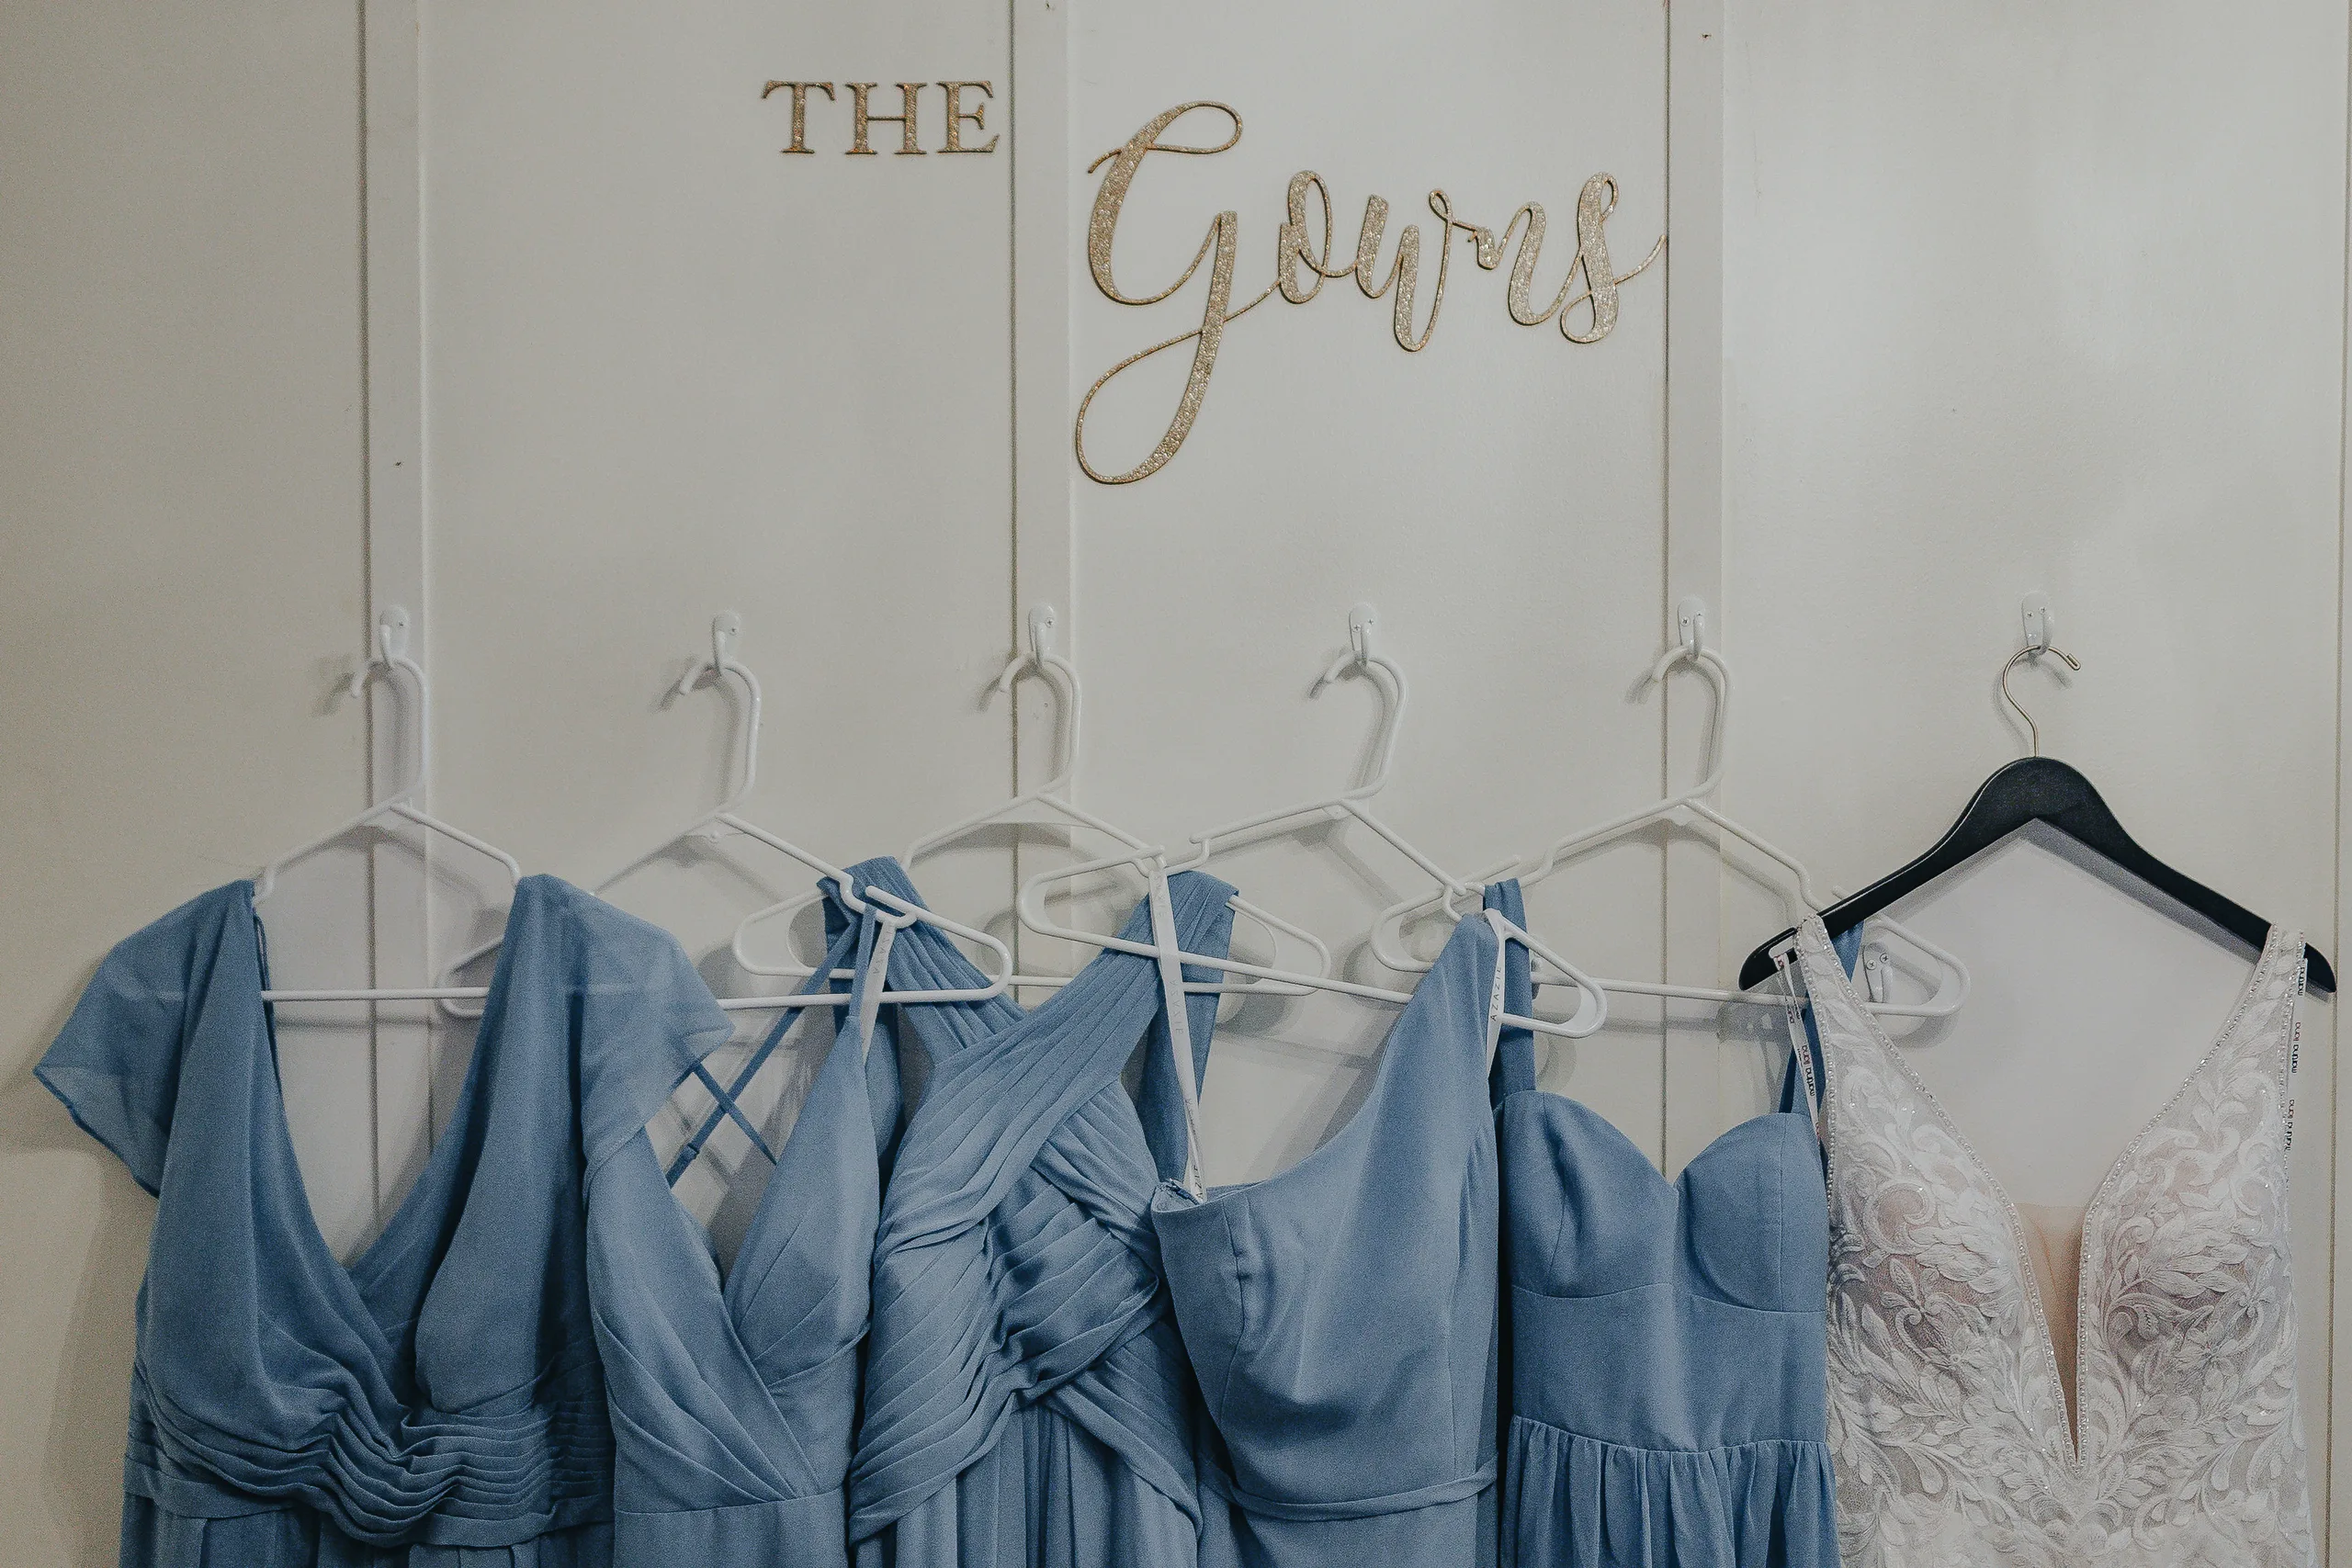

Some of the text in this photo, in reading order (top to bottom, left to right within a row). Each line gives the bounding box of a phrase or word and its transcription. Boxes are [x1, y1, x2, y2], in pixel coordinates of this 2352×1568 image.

[762, 80, 1668, 485] THE Gowns
[1489, 967, 1502, 1021] AZAZIE
[2290, 1043, 2300, 1074] martina
[1804, 1066, 1815, 1097] martina
